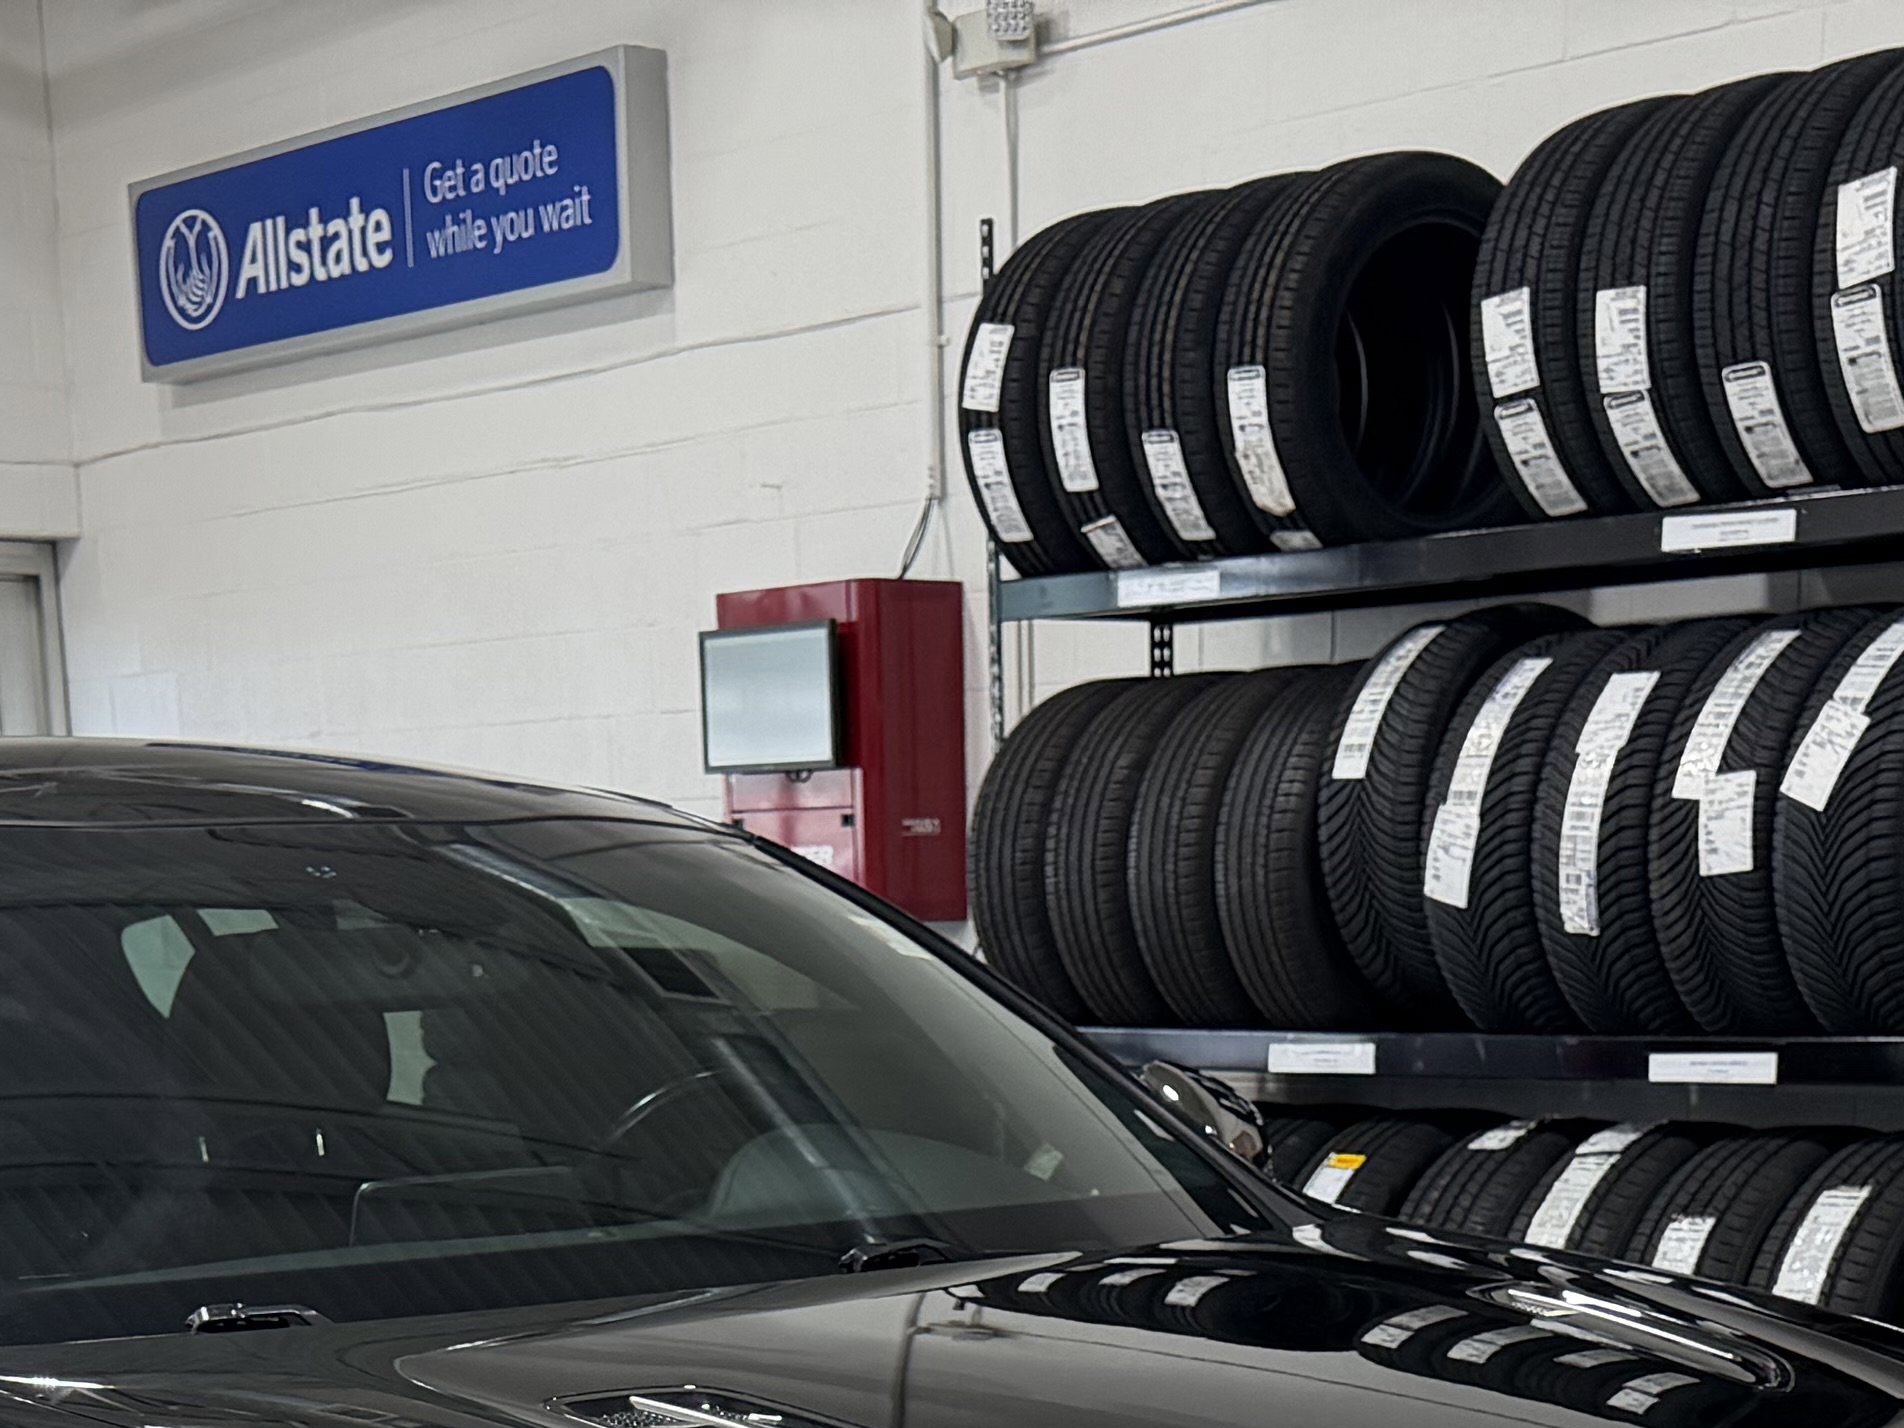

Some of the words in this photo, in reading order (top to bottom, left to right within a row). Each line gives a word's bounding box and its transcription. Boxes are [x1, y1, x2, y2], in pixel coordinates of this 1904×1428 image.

[424, 154, 466, 204] Get
[470, 162, 485, 194] a
[490, 139, 559, 196] quote
[235, 197, 394, 300] Allstate
[426, 208, 488, 260] while
[490, 207, 535, 255] you
[539, 185, 593, 234] wait
